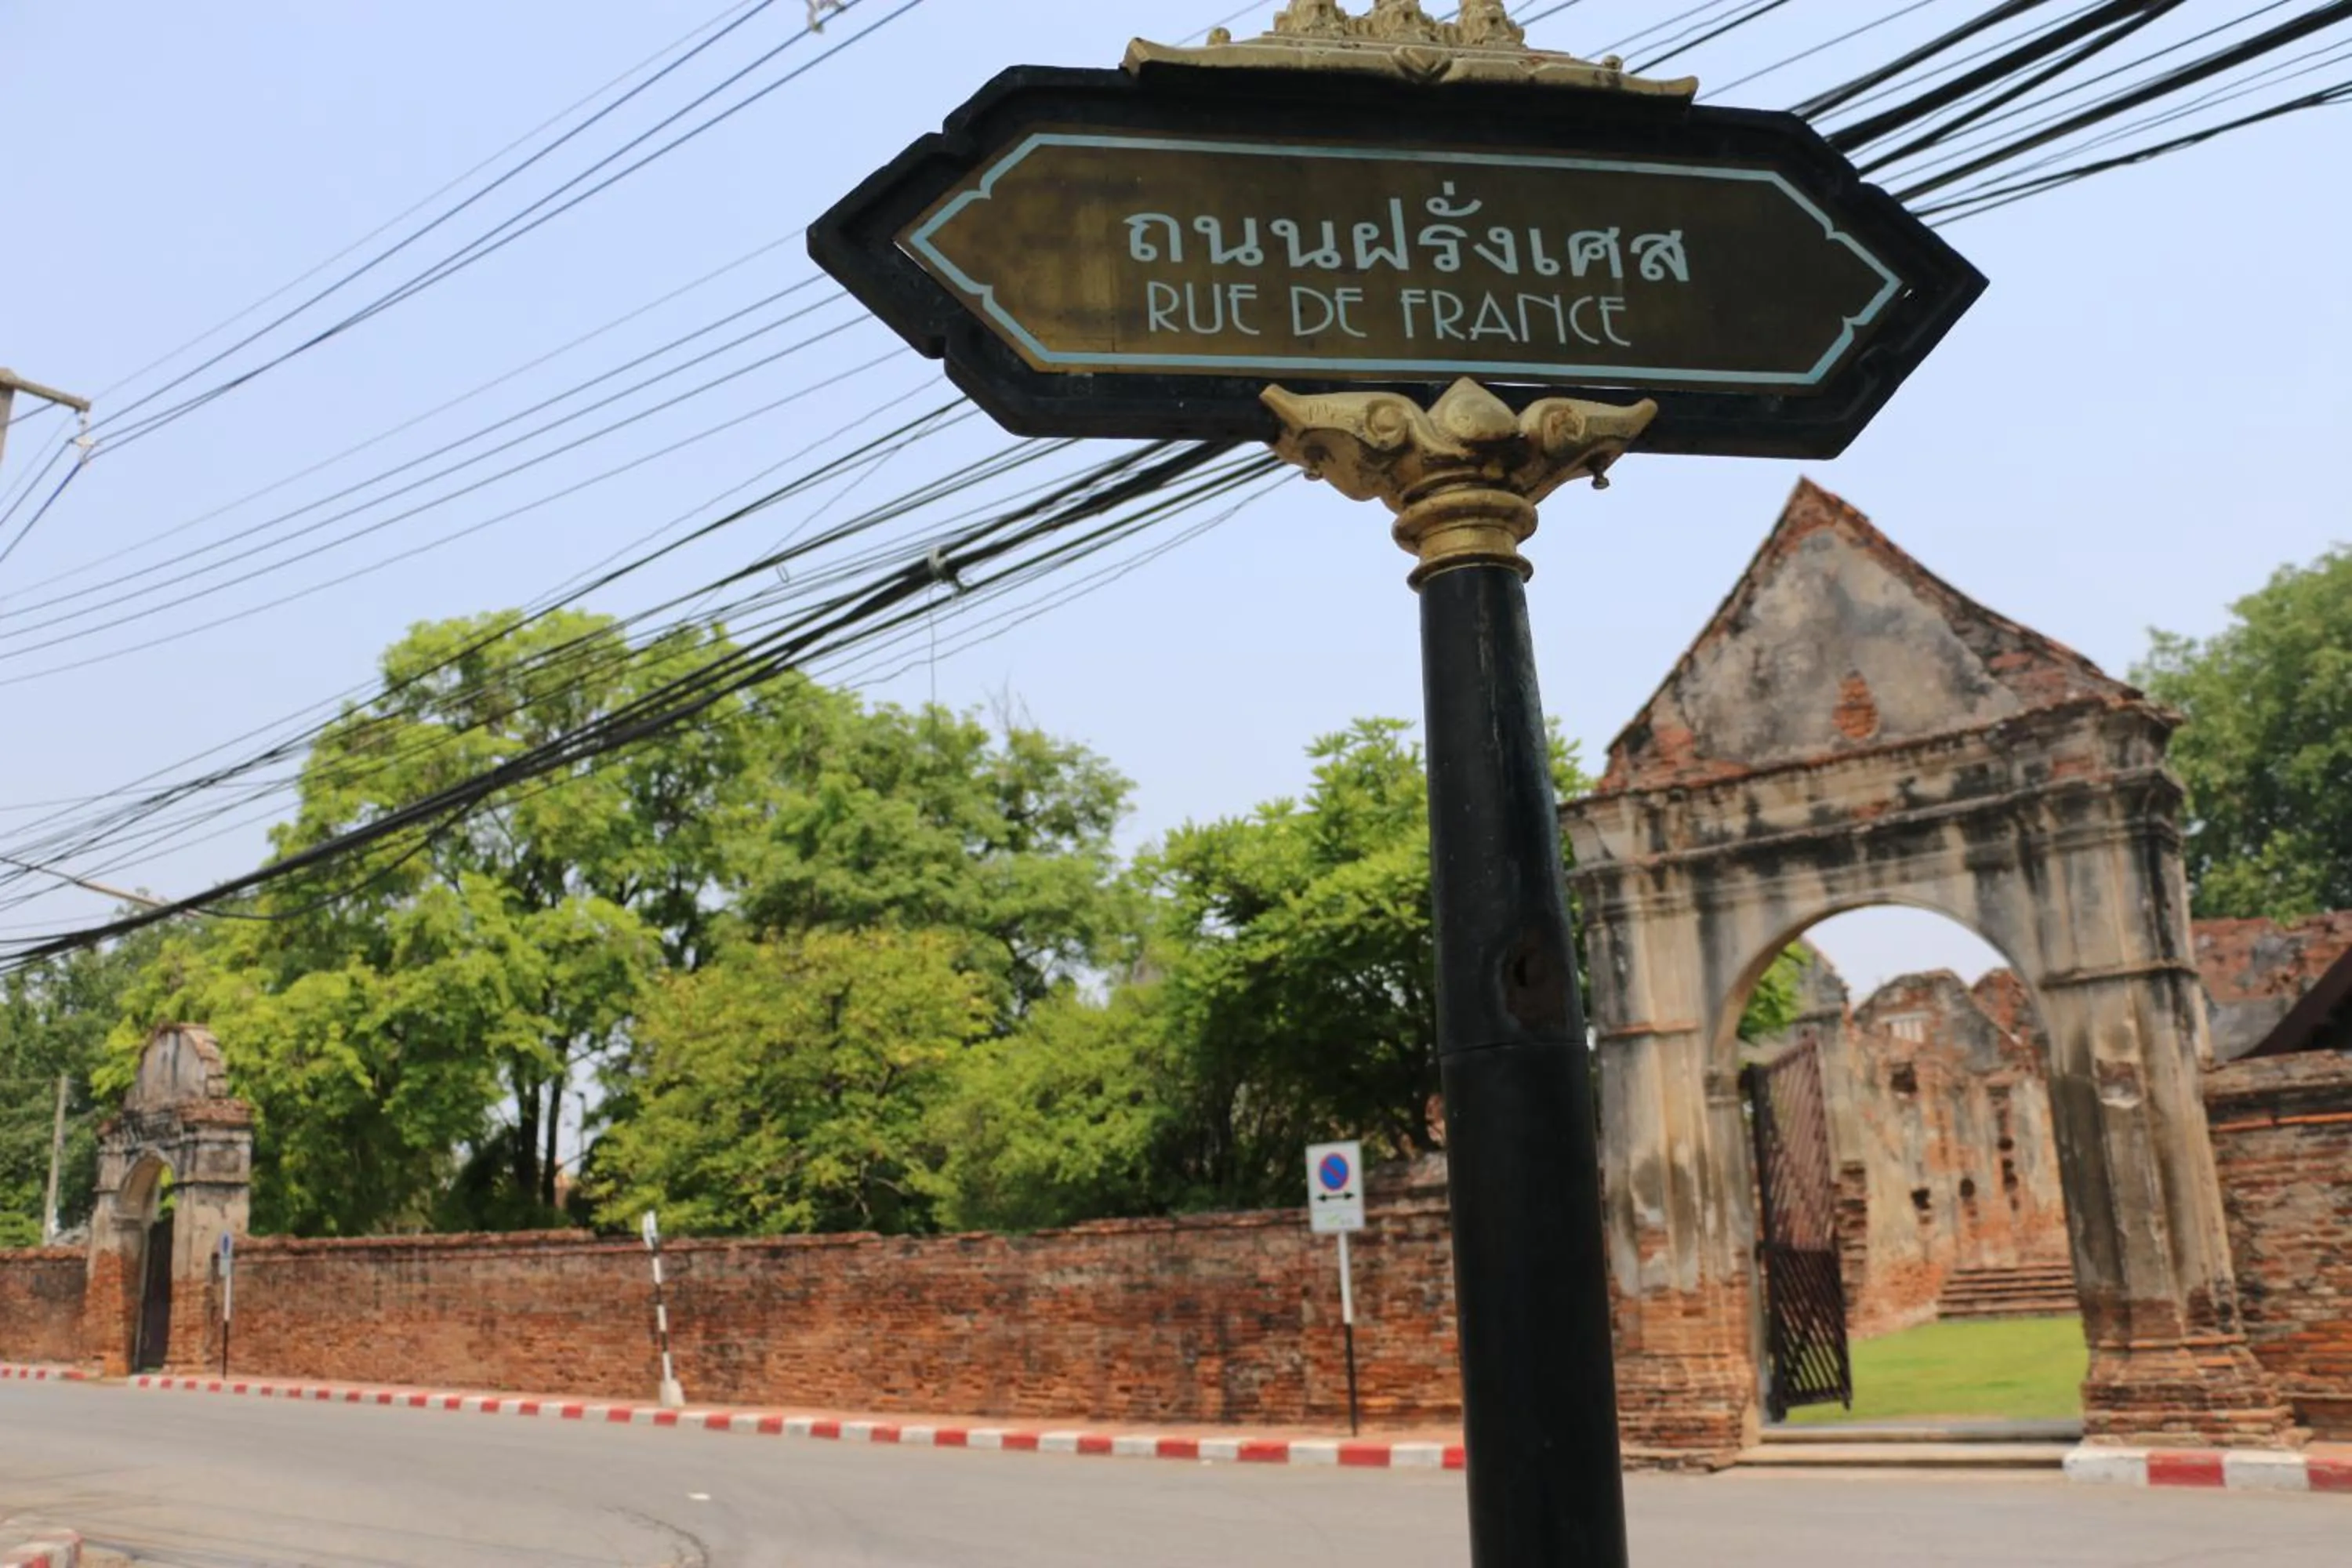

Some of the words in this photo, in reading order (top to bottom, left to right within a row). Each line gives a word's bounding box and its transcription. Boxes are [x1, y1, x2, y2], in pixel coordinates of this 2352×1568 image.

[1123, 181, 1689, 281] ถนนฝรั่งเศส
[1147, 281, 1260, 335] RUE
[1290, 286, 1367, 338] DE
[1400, 289, 1631, 347] FRANCE
